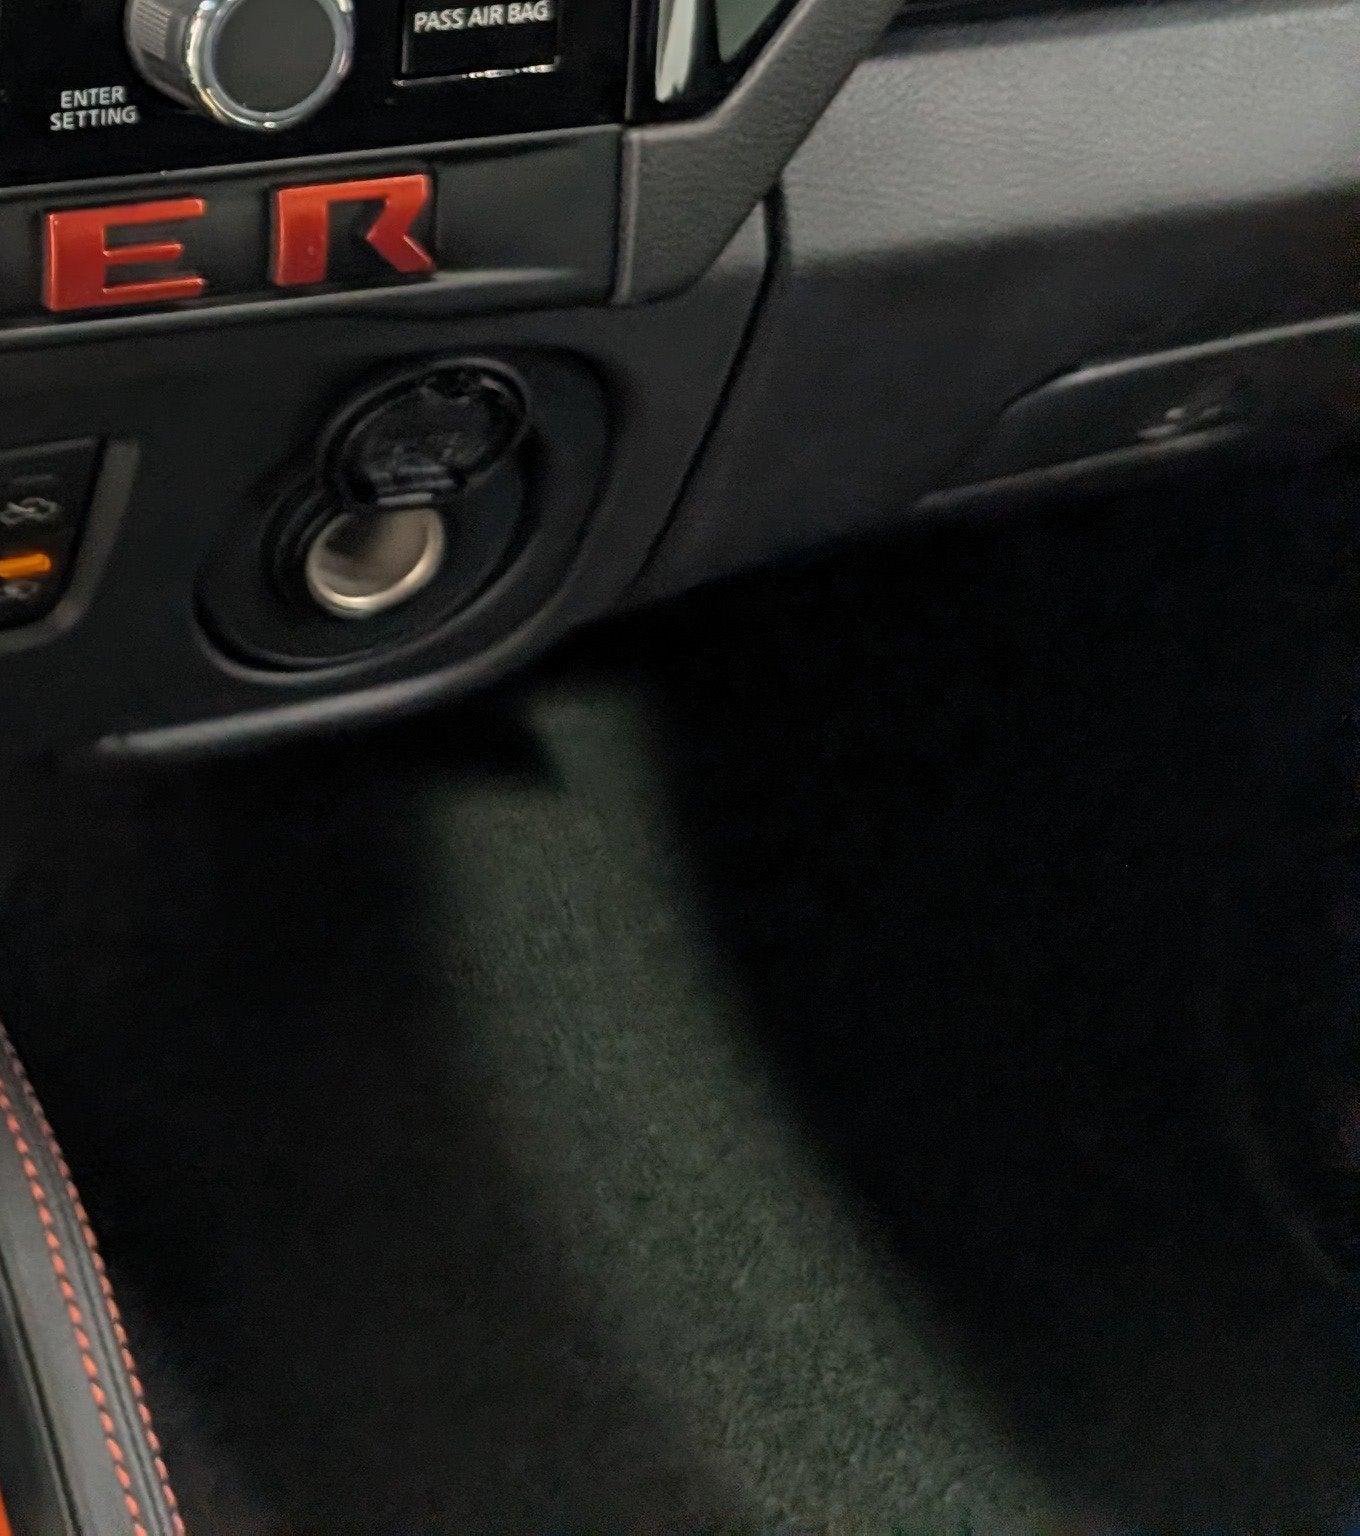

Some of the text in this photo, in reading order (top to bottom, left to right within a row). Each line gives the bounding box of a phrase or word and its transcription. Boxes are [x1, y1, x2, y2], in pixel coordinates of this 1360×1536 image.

[414, 0, 555, 34] PASS AIR BAG
[59, 85, 125, 109] ENTER
[50, 105, 139, 131] SETTING
